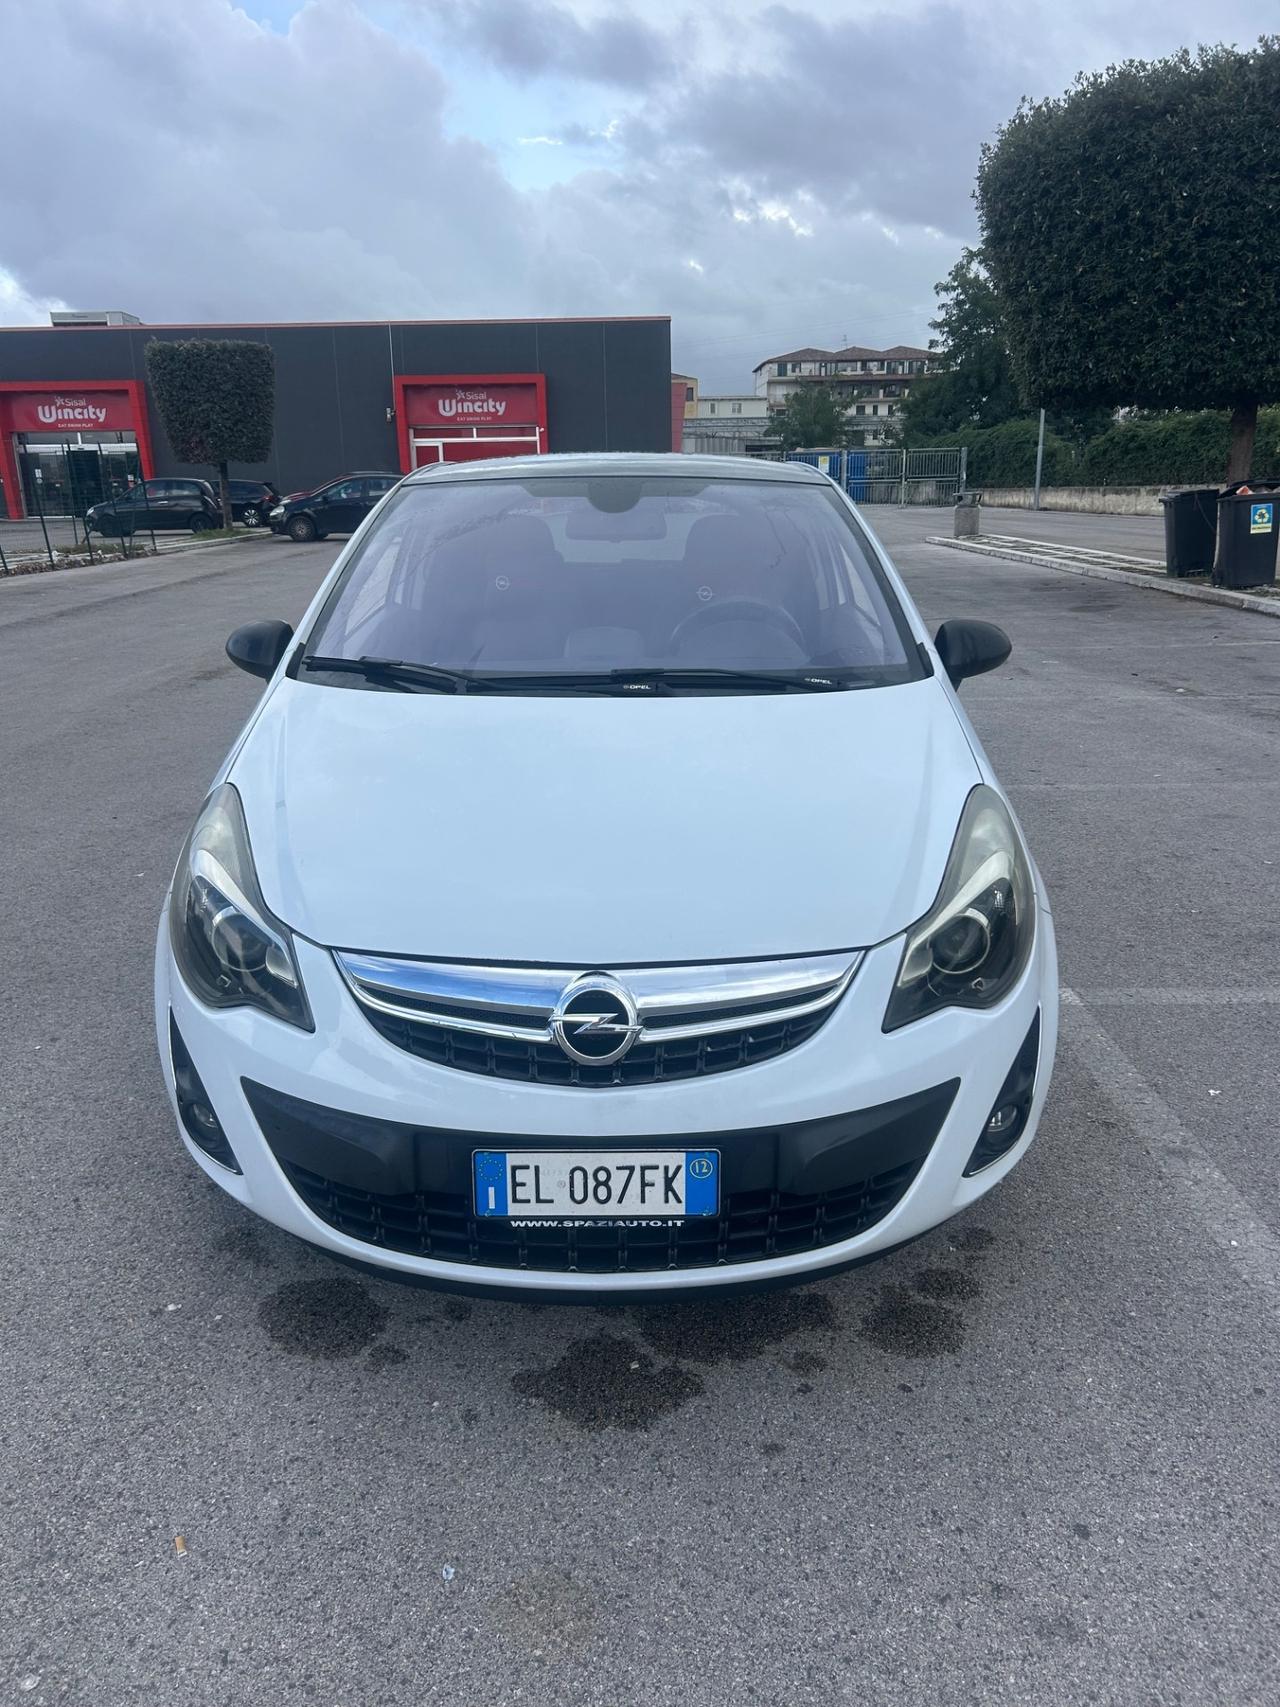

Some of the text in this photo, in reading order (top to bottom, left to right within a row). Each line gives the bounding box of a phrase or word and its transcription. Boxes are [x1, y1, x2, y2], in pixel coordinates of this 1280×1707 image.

[465, 391, 487, 400] Sisal
[64, 398, 87, 407] Sisal
[438, 398, 507, 417] Wincity
[37, 405, 107, 423] Wincity
[692, 1161, 709, 1174] 12
[510, 1164, 683, 1205] EL 087FK
[510, 1219, 686, 1228] WWW.SPAZIAUTO.IT
